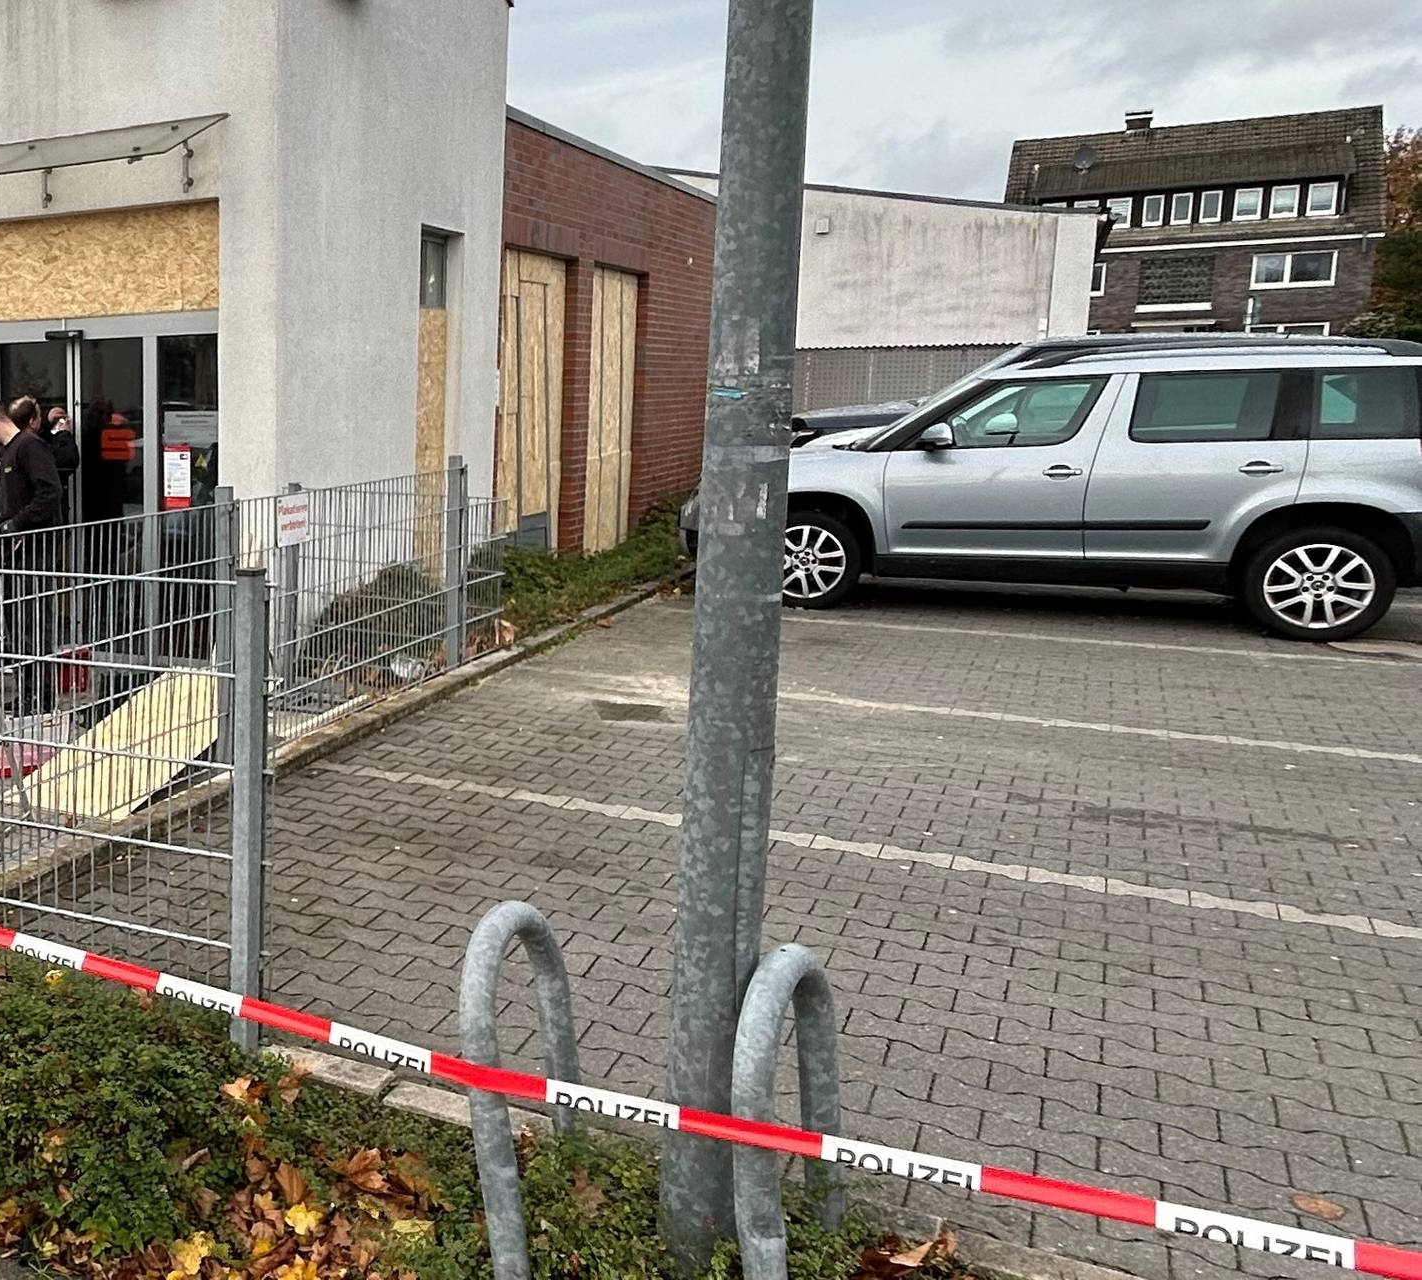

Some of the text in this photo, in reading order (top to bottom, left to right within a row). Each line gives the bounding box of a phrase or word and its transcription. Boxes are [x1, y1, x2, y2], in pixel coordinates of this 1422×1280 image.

[339, 1037, 427, 1073] POLIZEI
[555, 1092, 672, 1130] POLIZEI
[835, 1147, 974, 1191] POLIZEI
[1174, 1217, 1344, 1267] POLIZEI
